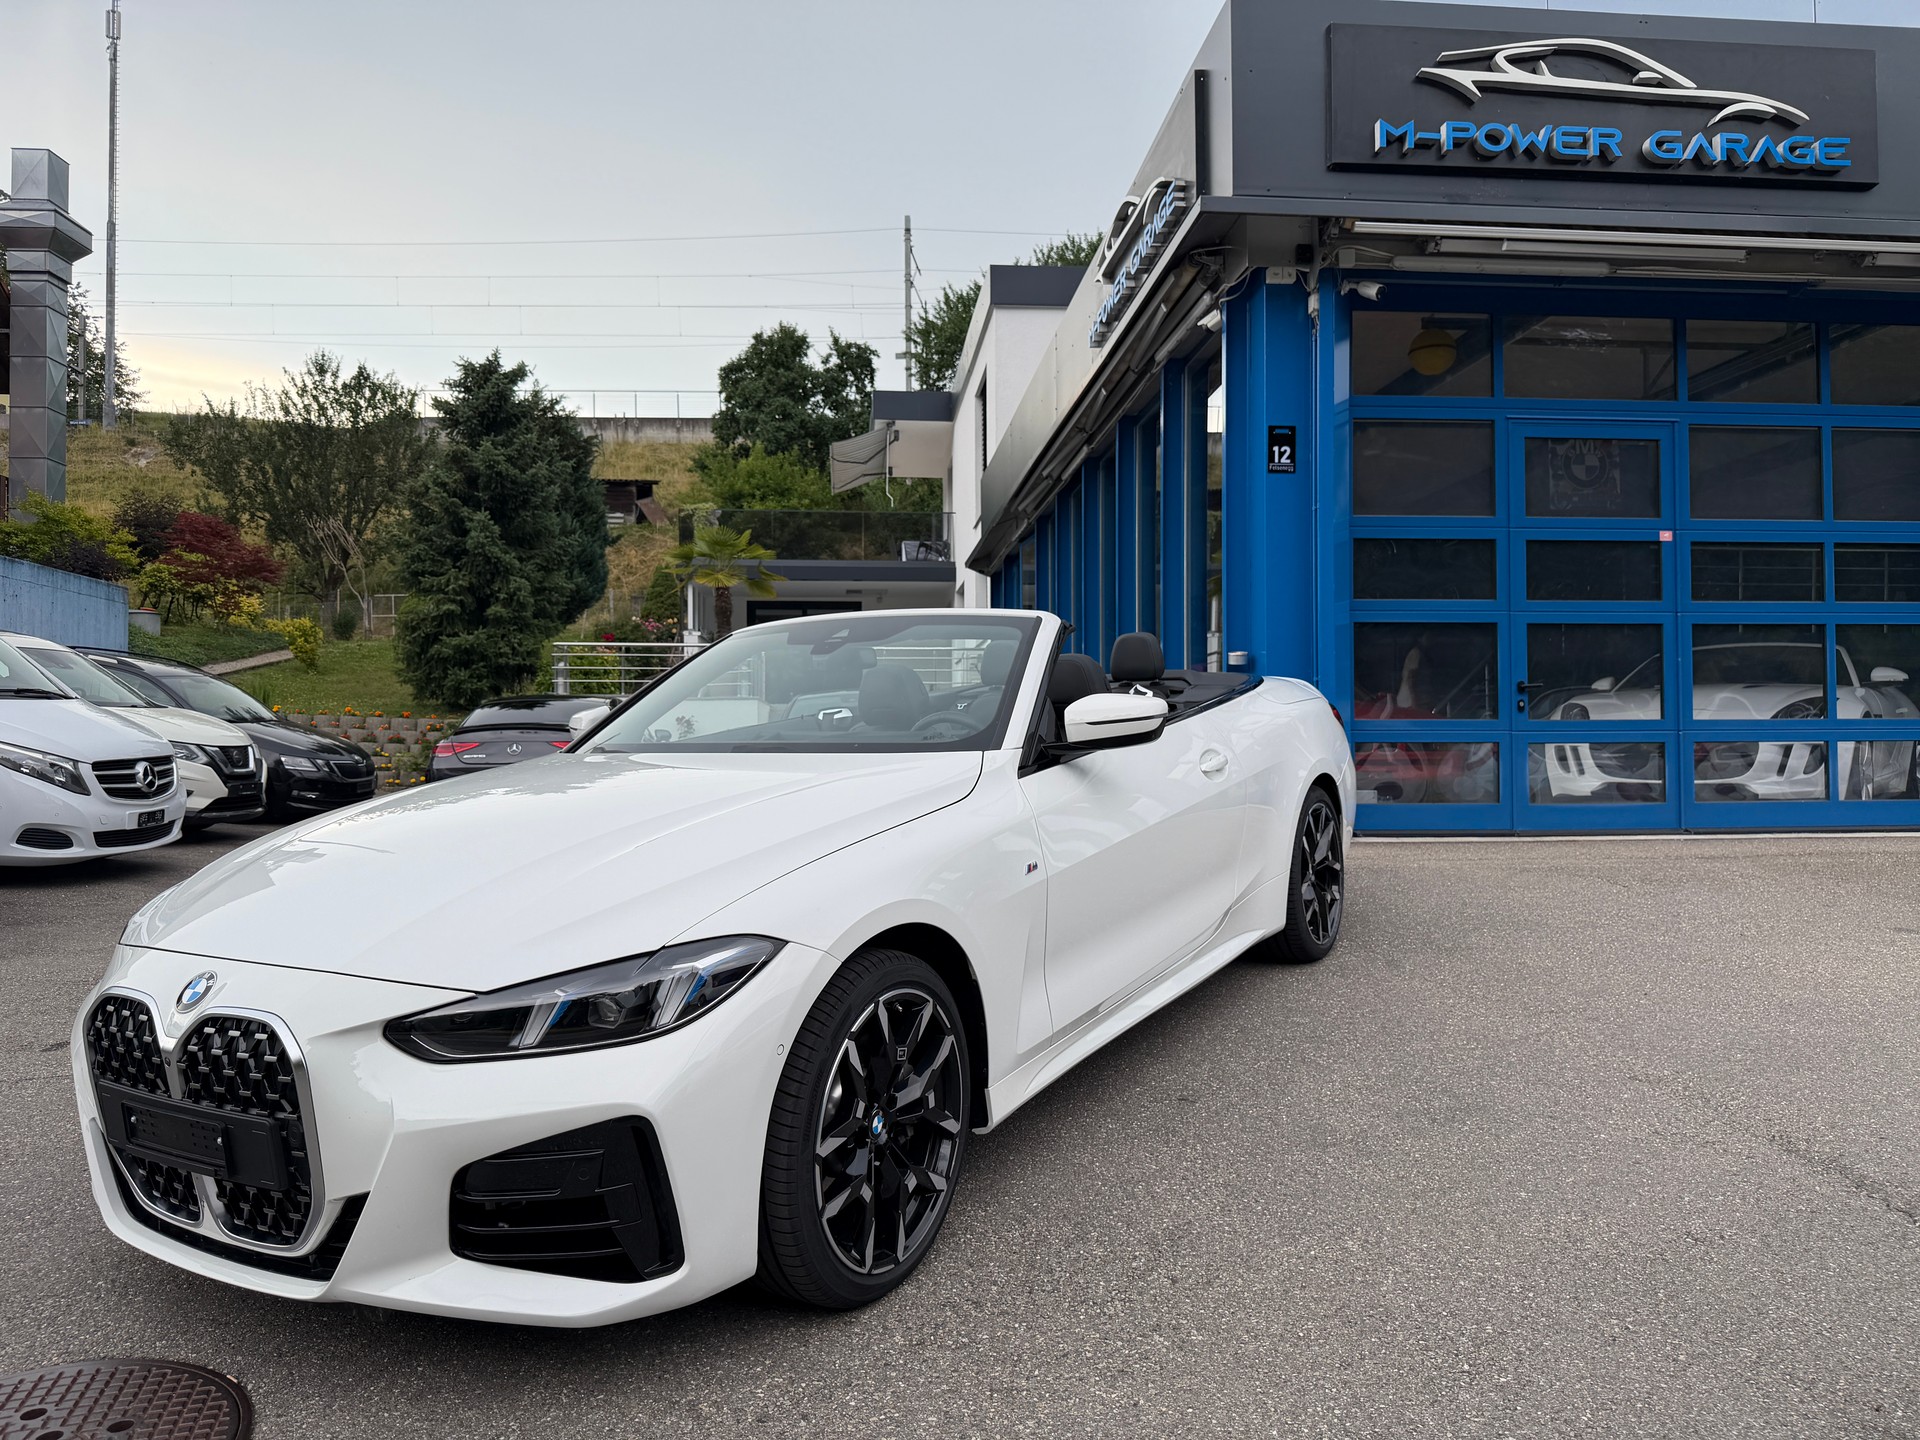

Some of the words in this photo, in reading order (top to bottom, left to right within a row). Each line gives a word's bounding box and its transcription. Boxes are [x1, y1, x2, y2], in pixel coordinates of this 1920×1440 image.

[1375, 118, 1623, 157] M-POWER
[1647, 129, 1852, 167] GARAGE
[1130, 179, 1179, 275] GARAGE
[1272, 445, 1291, 463] 12
